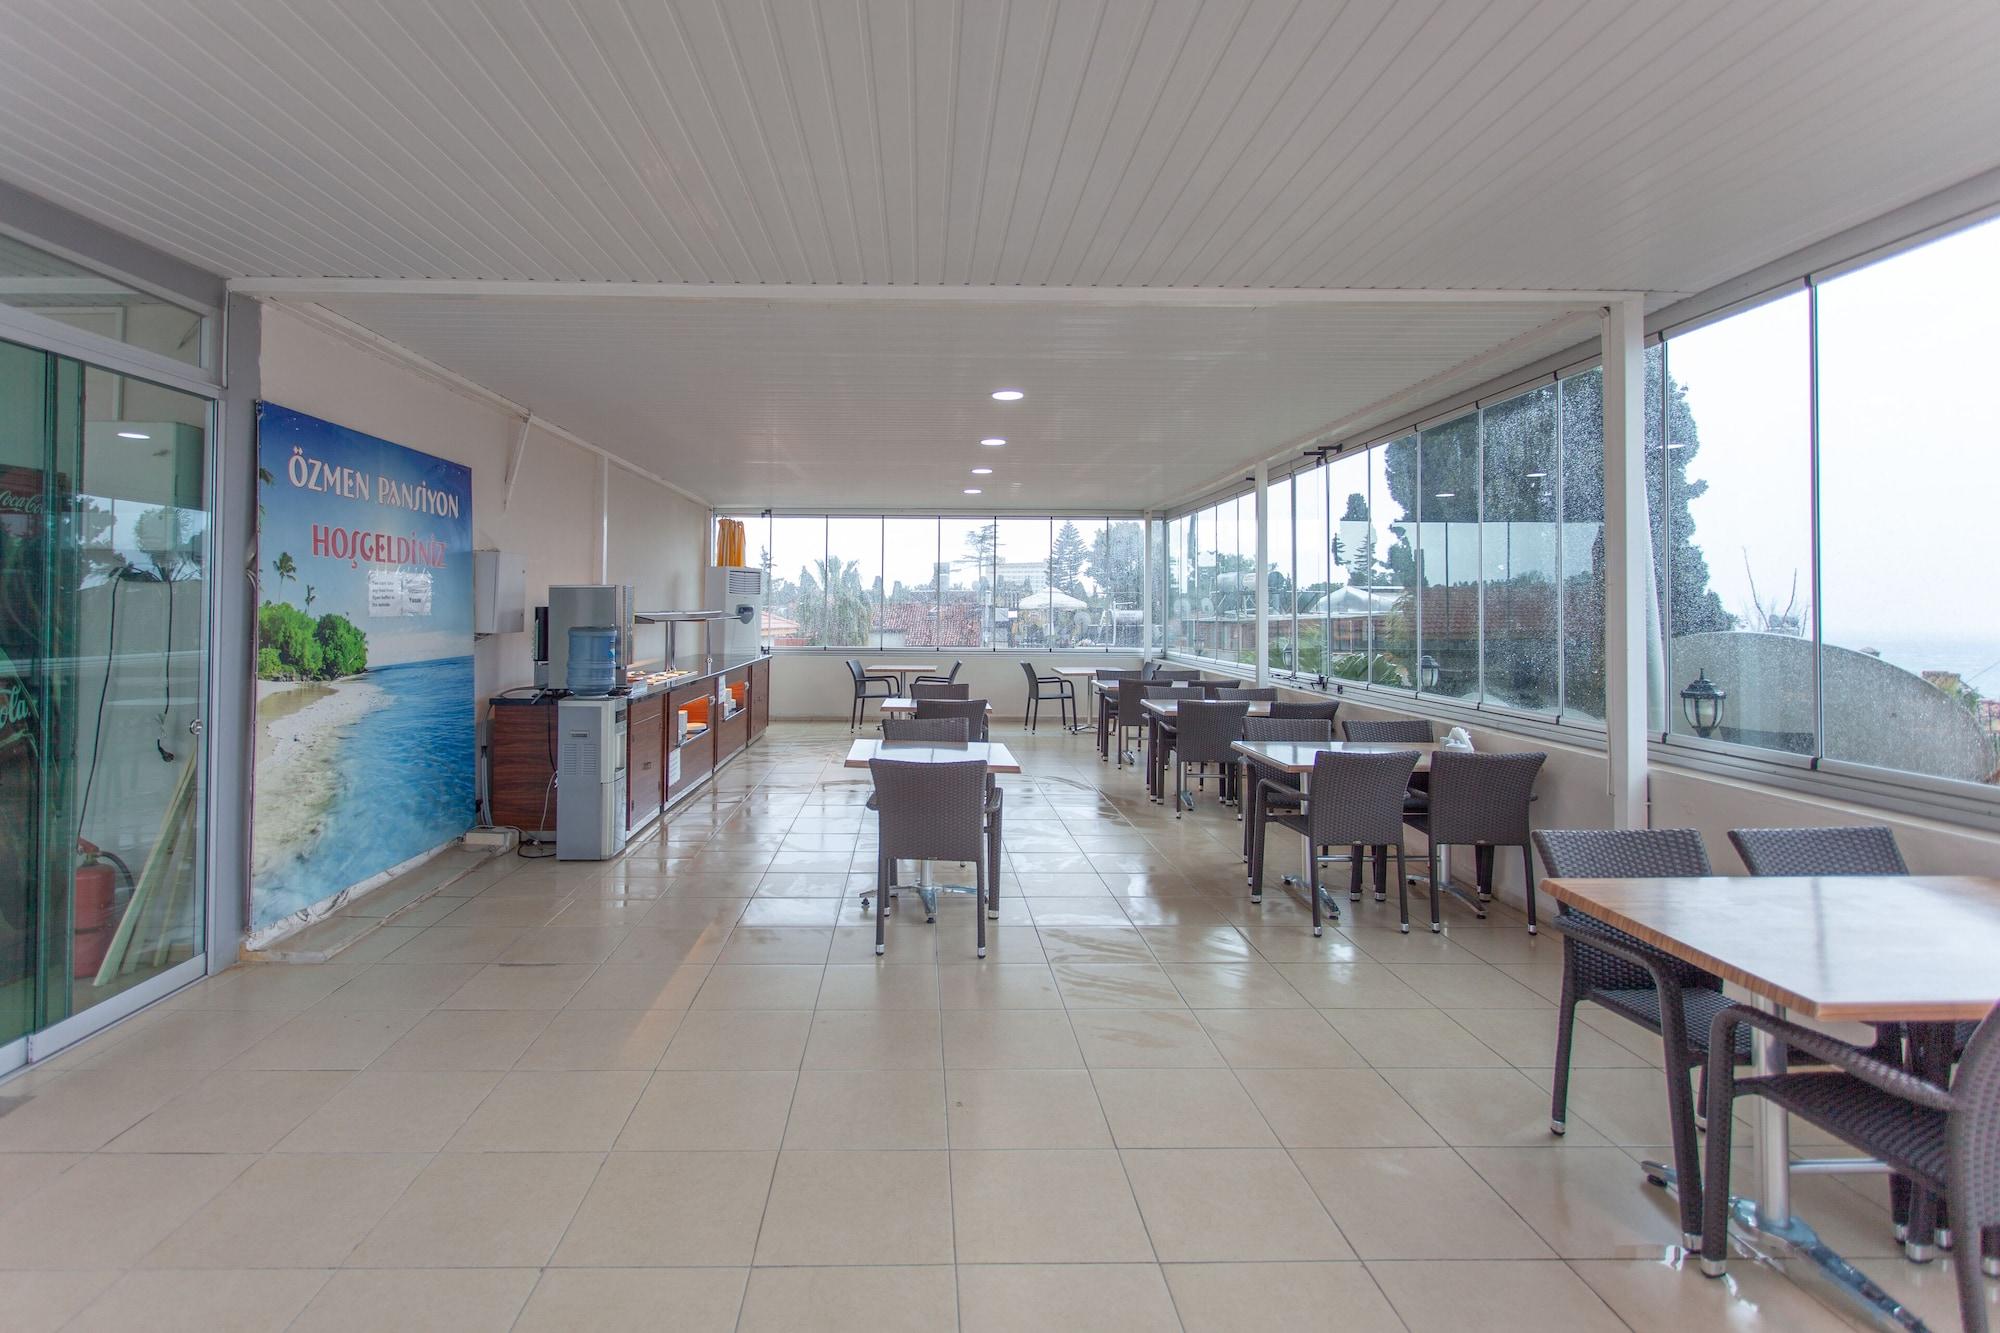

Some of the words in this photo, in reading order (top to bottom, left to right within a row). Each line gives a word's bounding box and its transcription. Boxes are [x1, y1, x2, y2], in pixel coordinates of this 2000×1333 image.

[288, 445, 370, 501] ÖZMEN
[377, 476, 459, 520] PANSİYON
[312, 524, 449, 569] HOŞGELDİNİZ
